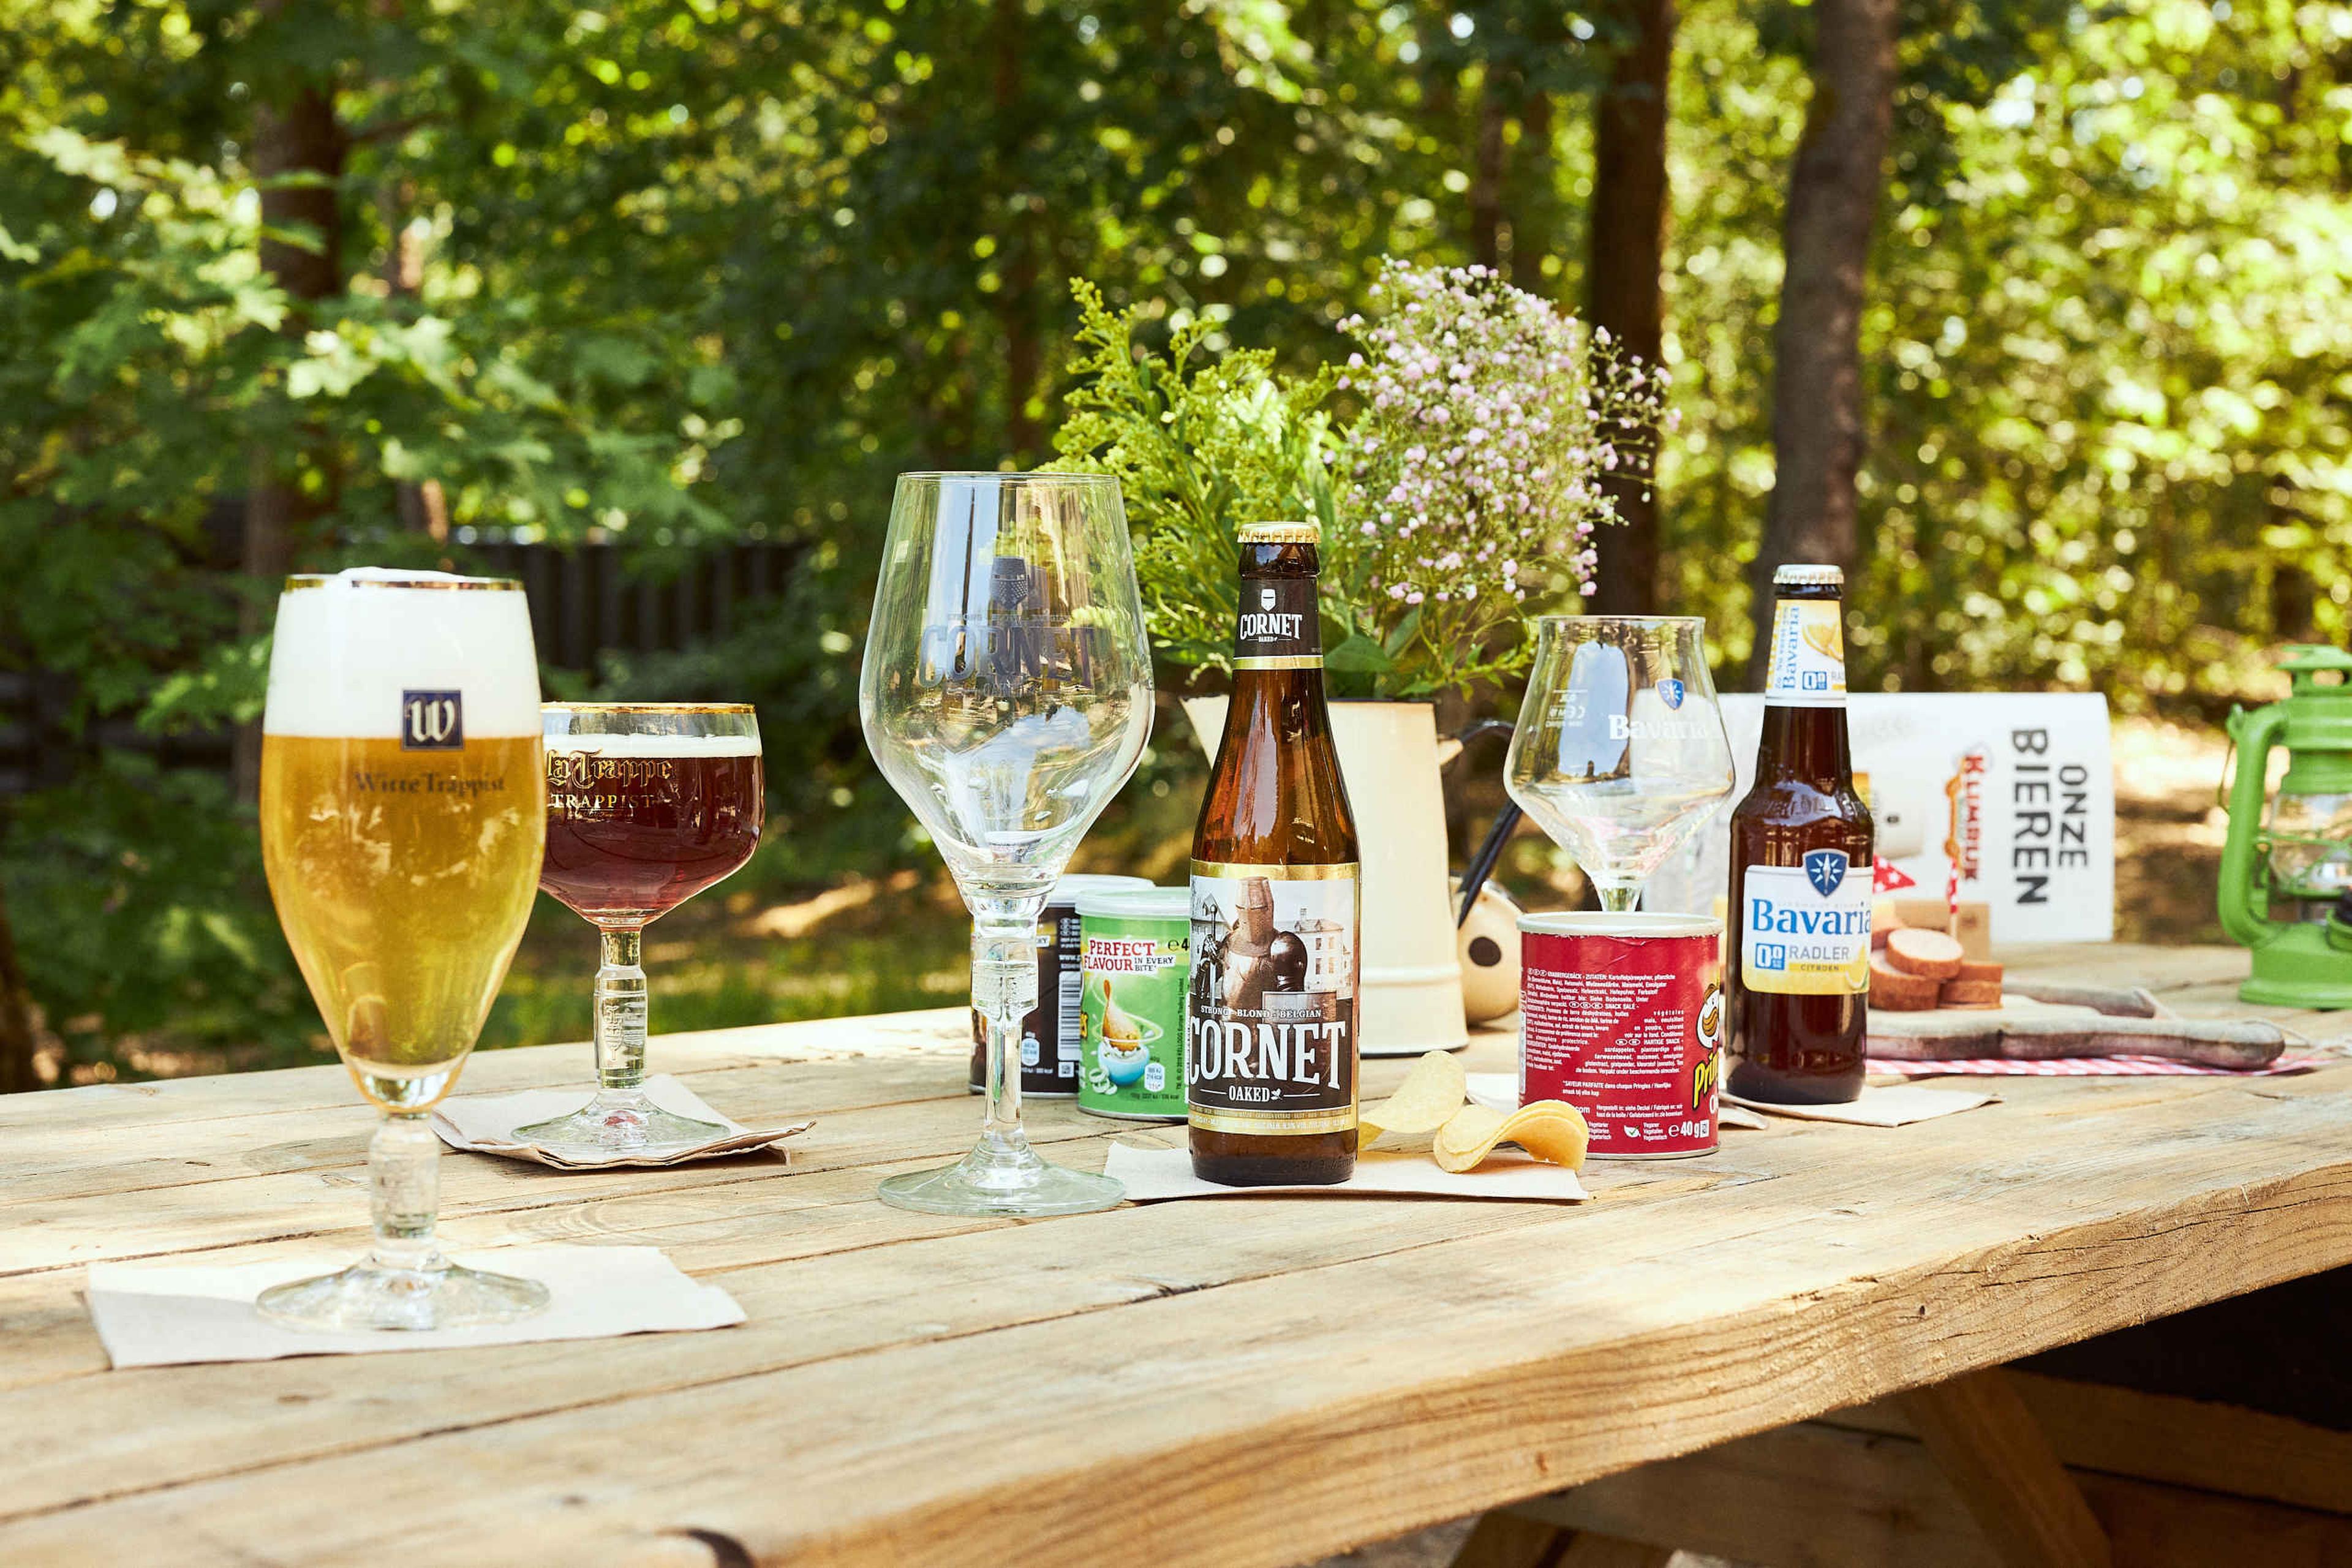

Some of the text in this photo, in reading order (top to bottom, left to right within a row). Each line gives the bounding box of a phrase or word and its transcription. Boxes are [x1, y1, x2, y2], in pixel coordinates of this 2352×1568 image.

[1240, 613, 1302, 640] CORNET
[410, 698, 455, 742] W
[568, 747, 673, 789] Trappe
[353, 769, 505, 797] Witte Trappist
[551, 794, 654, 809] TRAPPIST
[2011, 728, 2052, 904] BIEREN
[2058, 765, 2088, 867] ONZE
[1089, 938, 1156, 956] PERFECT
[1789, 946, 1850, 960] RADLER
[1084, 957, 1134, 971] FLAVOUR
[1145, 956, 1175, 965] EVERY
[1200, 1005, 1322, 1019] STRONG BLOND BELGIAN
[1189, 1016, 1346, 1090] CORNET
[1229, 1085, 1270, 1102] OAKED
